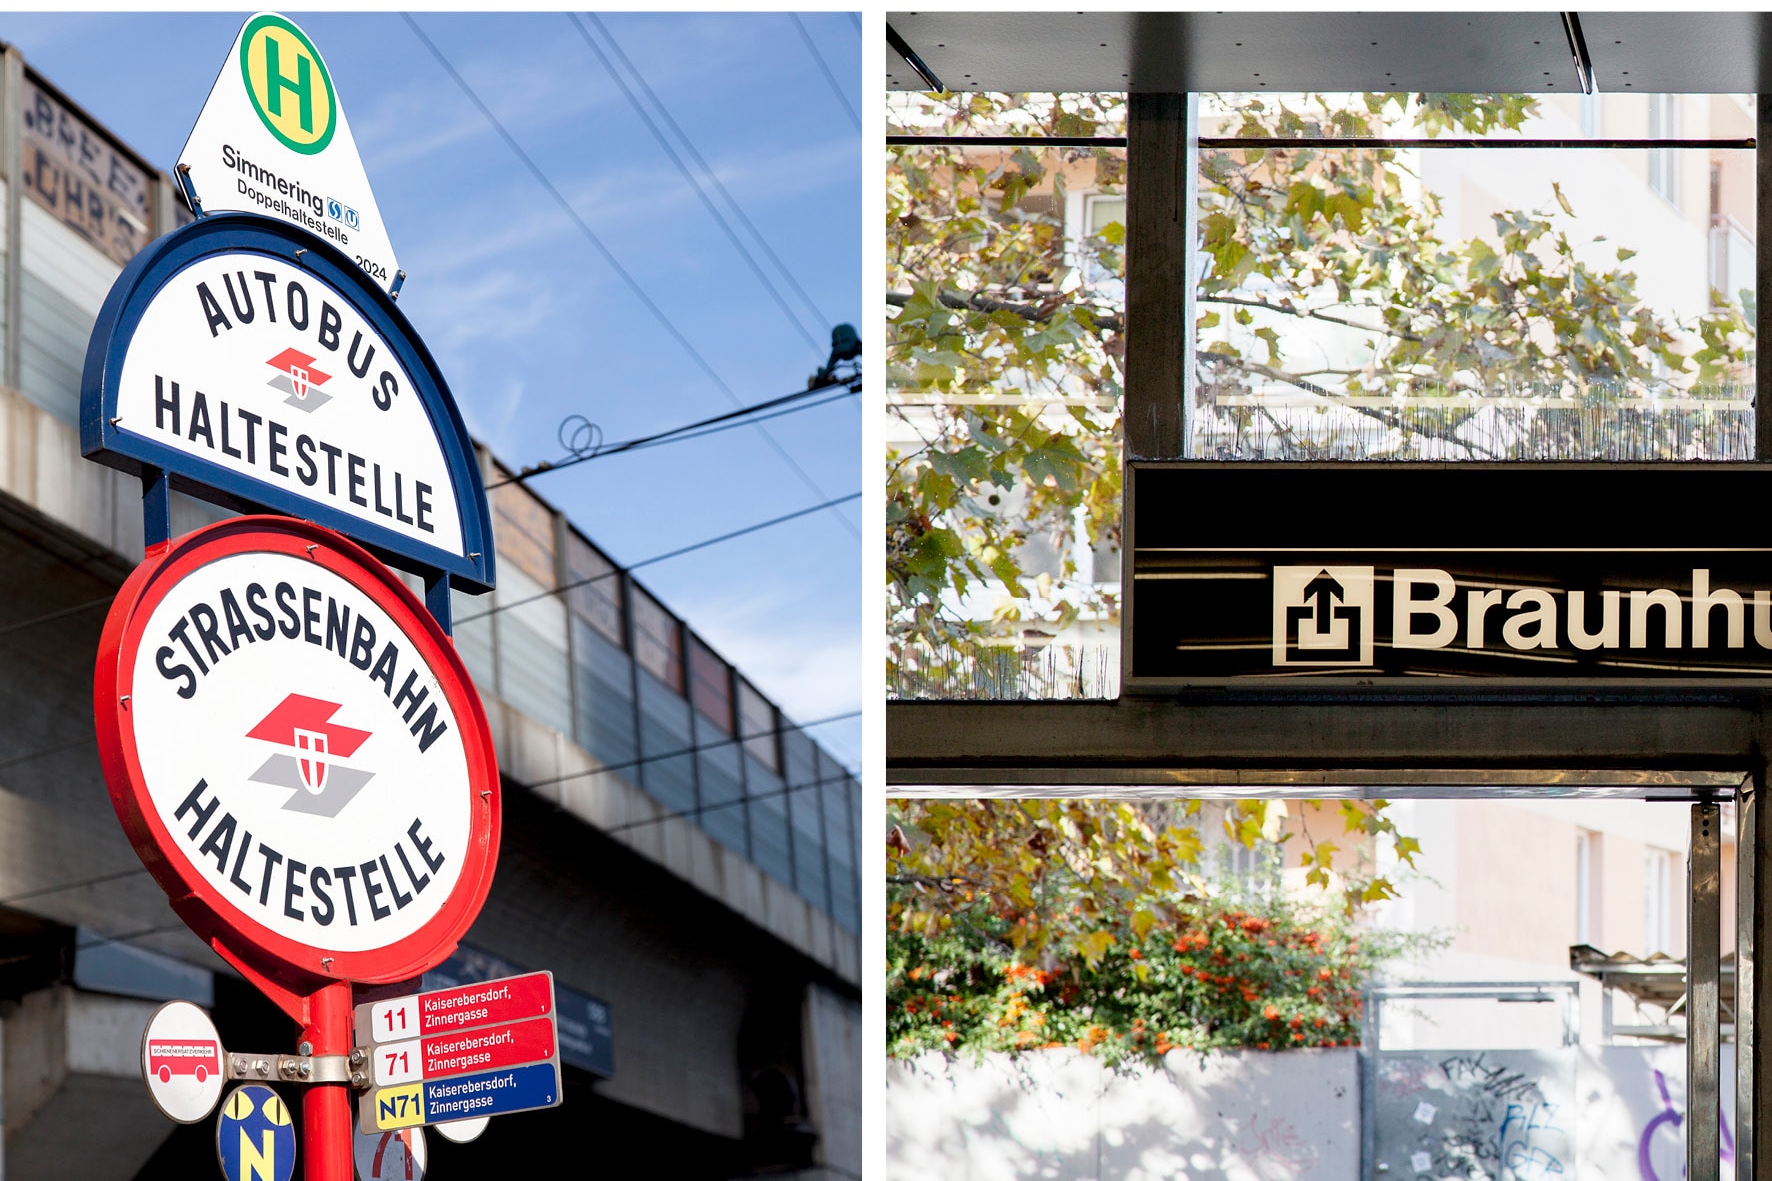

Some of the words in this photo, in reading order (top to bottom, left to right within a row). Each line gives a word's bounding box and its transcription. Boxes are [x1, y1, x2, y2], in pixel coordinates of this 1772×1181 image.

[265, 35, 314, 134] H
[222, 144, 324, 218] Simmering
[237, 178, 349, 245] Doppelhaltestelle
[355, 254, 388, 281] 2024
[195, 271, 399, 412] AUTOBUS
[154, 375, 436, 534] HALTESTELLE
[155, 581, 448, 754] STRASSENBAHN
[174, 778, 446, 928] HALTESTELLE
[384, 1007, 407, 1032] 11
[424, 985, 511, 1012] Kaiserebersdorf,
[425, 1007, 488, 1028] Zinnergasse
[386, 1051, 409, 1076] 71
[427, 1030, 514, 1056] Kaiserebersdorf,
[428, 1051, 491, 1072] Zinnergasse
[379, 1093, 420, 1121] N71
[429, 1074, 517, 1099] Kaiserebersdorf,
[430, 1095, 494, 1115] Zinnergasse
[239, 1125, 275, 1181] N
